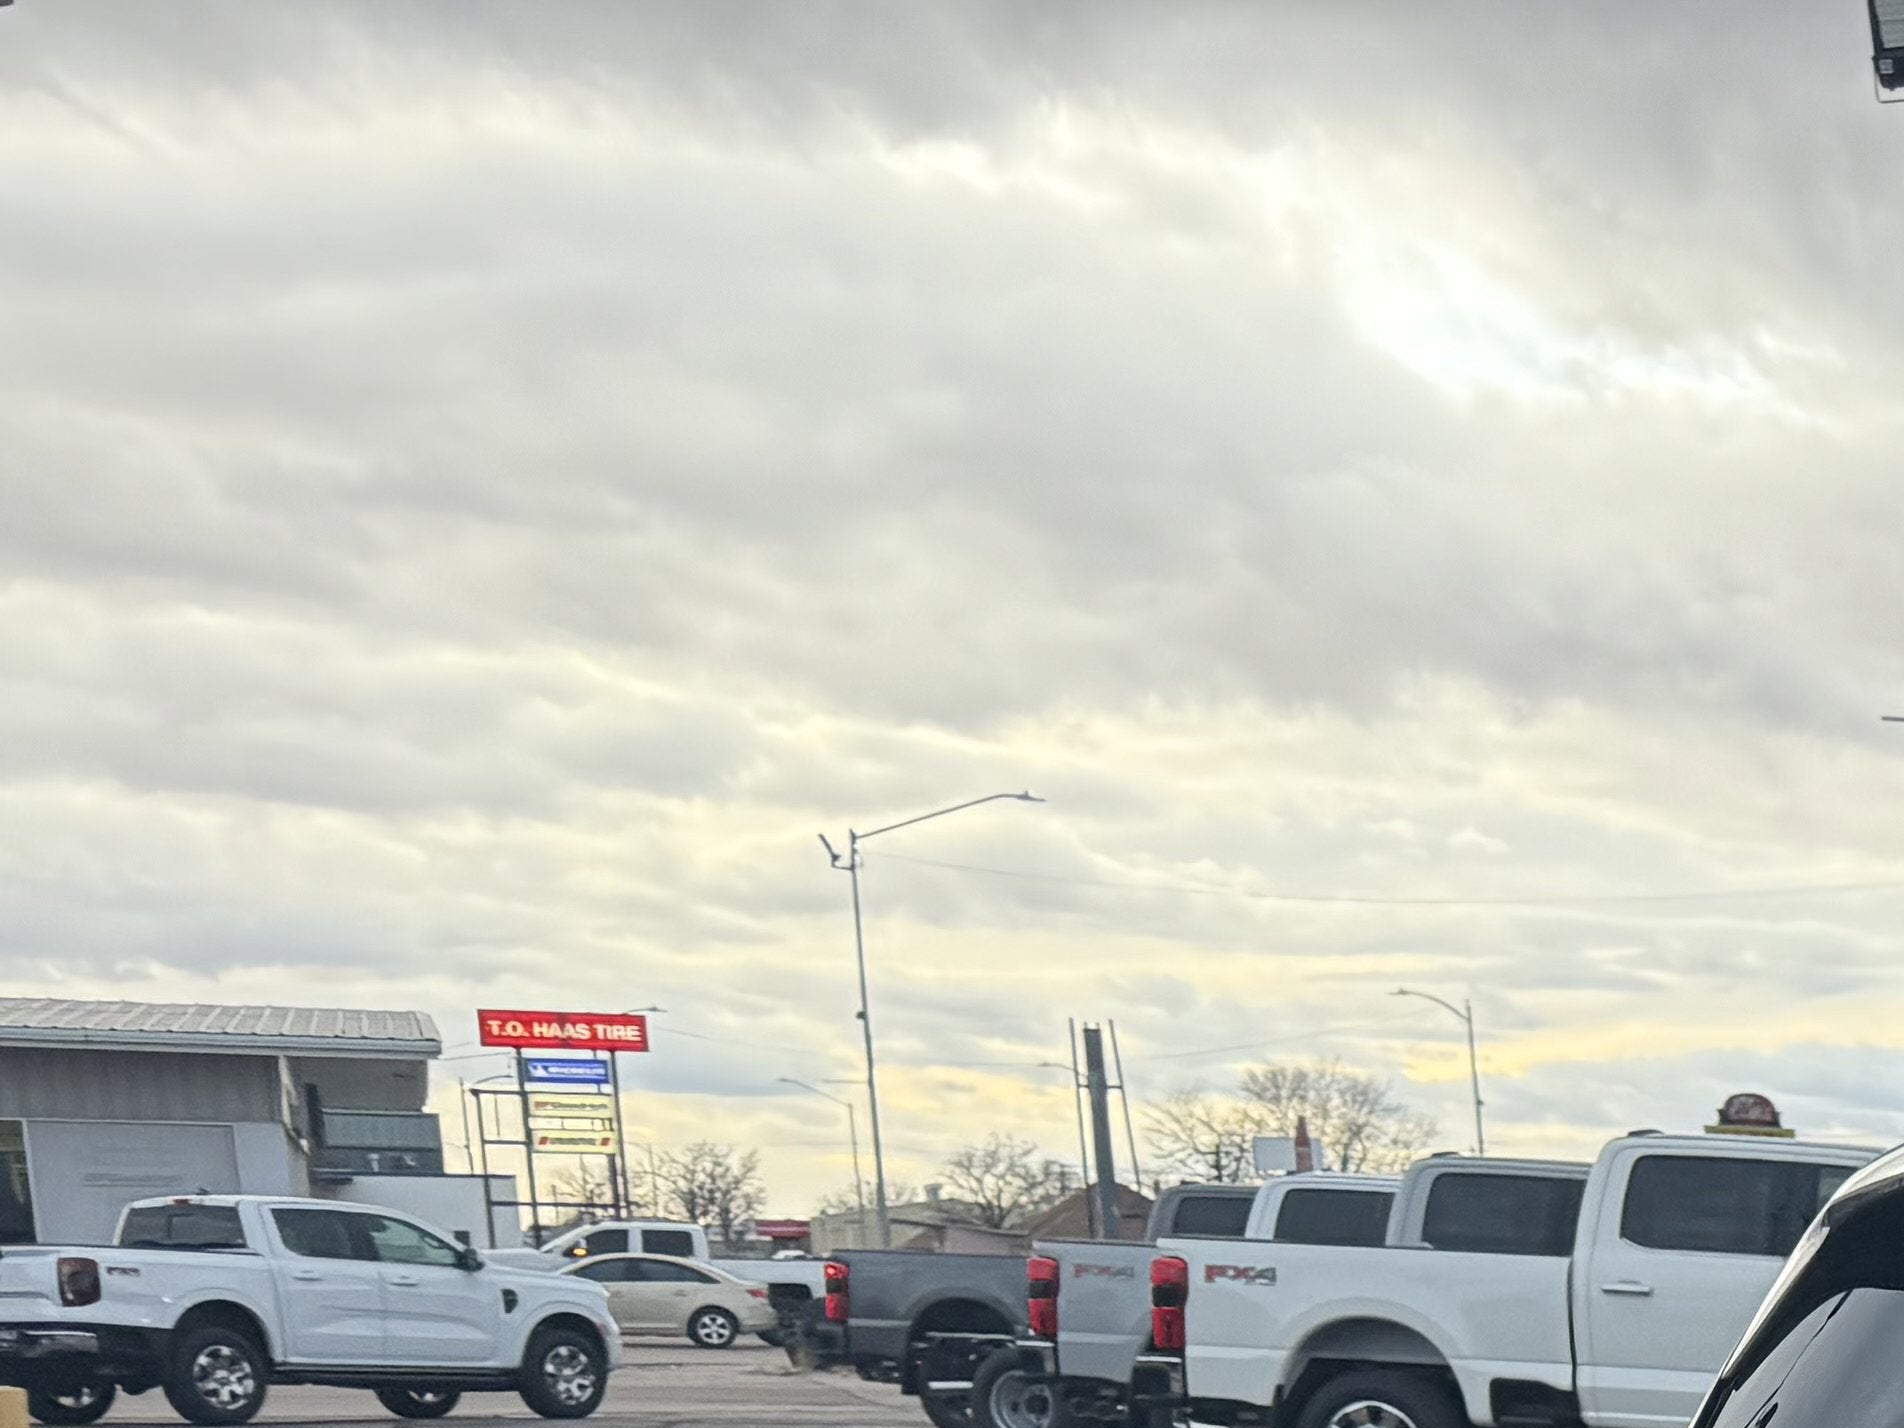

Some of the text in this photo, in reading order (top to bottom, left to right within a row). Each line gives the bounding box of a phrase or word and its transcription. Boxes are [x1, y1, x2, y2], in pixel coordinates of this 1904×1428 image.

[487, 1020, 642, 1041] T.O. HAAS TIRE
